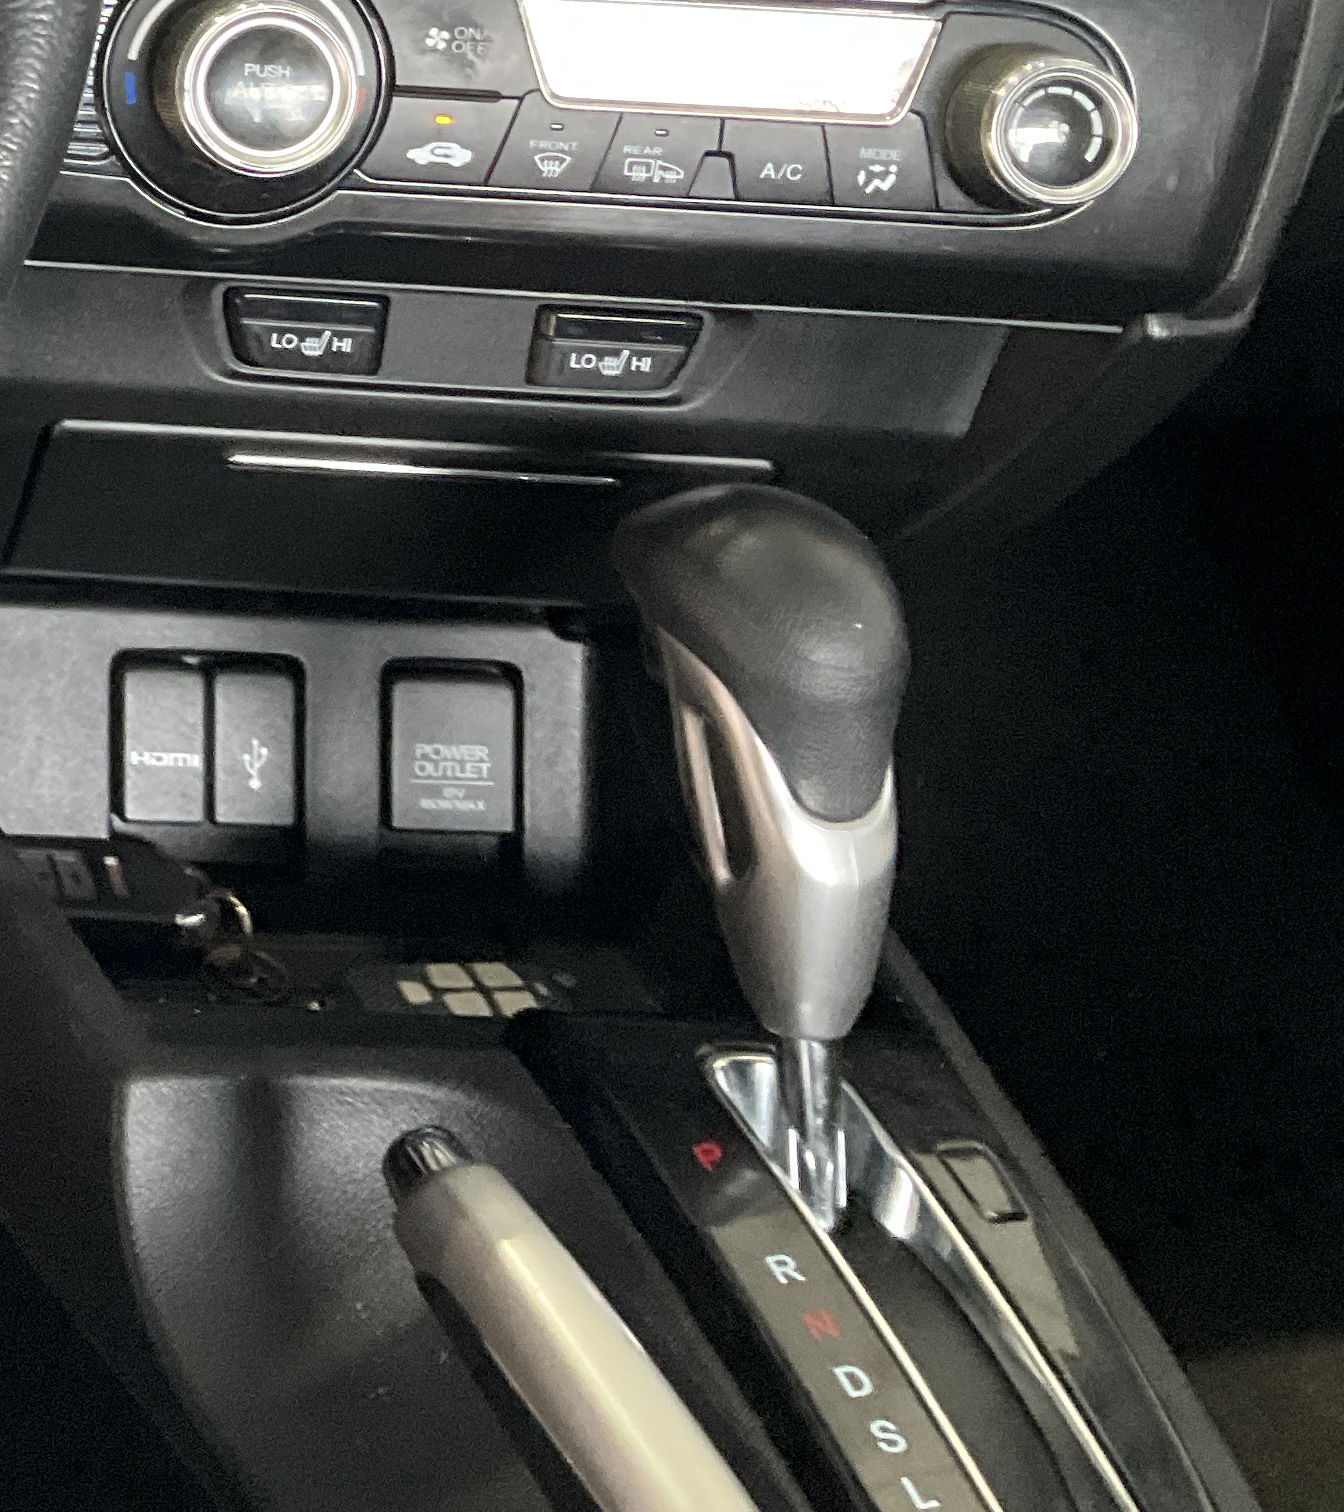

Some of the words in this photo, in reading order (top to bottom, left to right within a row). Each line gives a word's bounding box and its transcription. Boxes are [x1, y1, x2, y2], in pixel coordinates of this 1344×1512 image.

[243, 62, 291, 78] PUSH
[529, 139, 579, 152] FRONT
[622, 144, 664, 156] REAR
[859, 146, 902, 162] MODE
[759, 161, 804, 181] A/C
[270, 332, 300, 349] LO
[331, 336, 353, 354] HI
[568, 351, 598, 369] LO
[629, 355, 653, 373] HI
[414, 742, 490, 761] POWER
[413, 760, 492, 779] OUTLET
[692, 1140, 723, 1173] P
[764, 1253, 806, 1285] R
[801, 1306, 843, 1341] N
[831, 1364, 874, 1399] D
[868, 1418, 908, 1454] S
[899, 1475, 942, 1510] L
